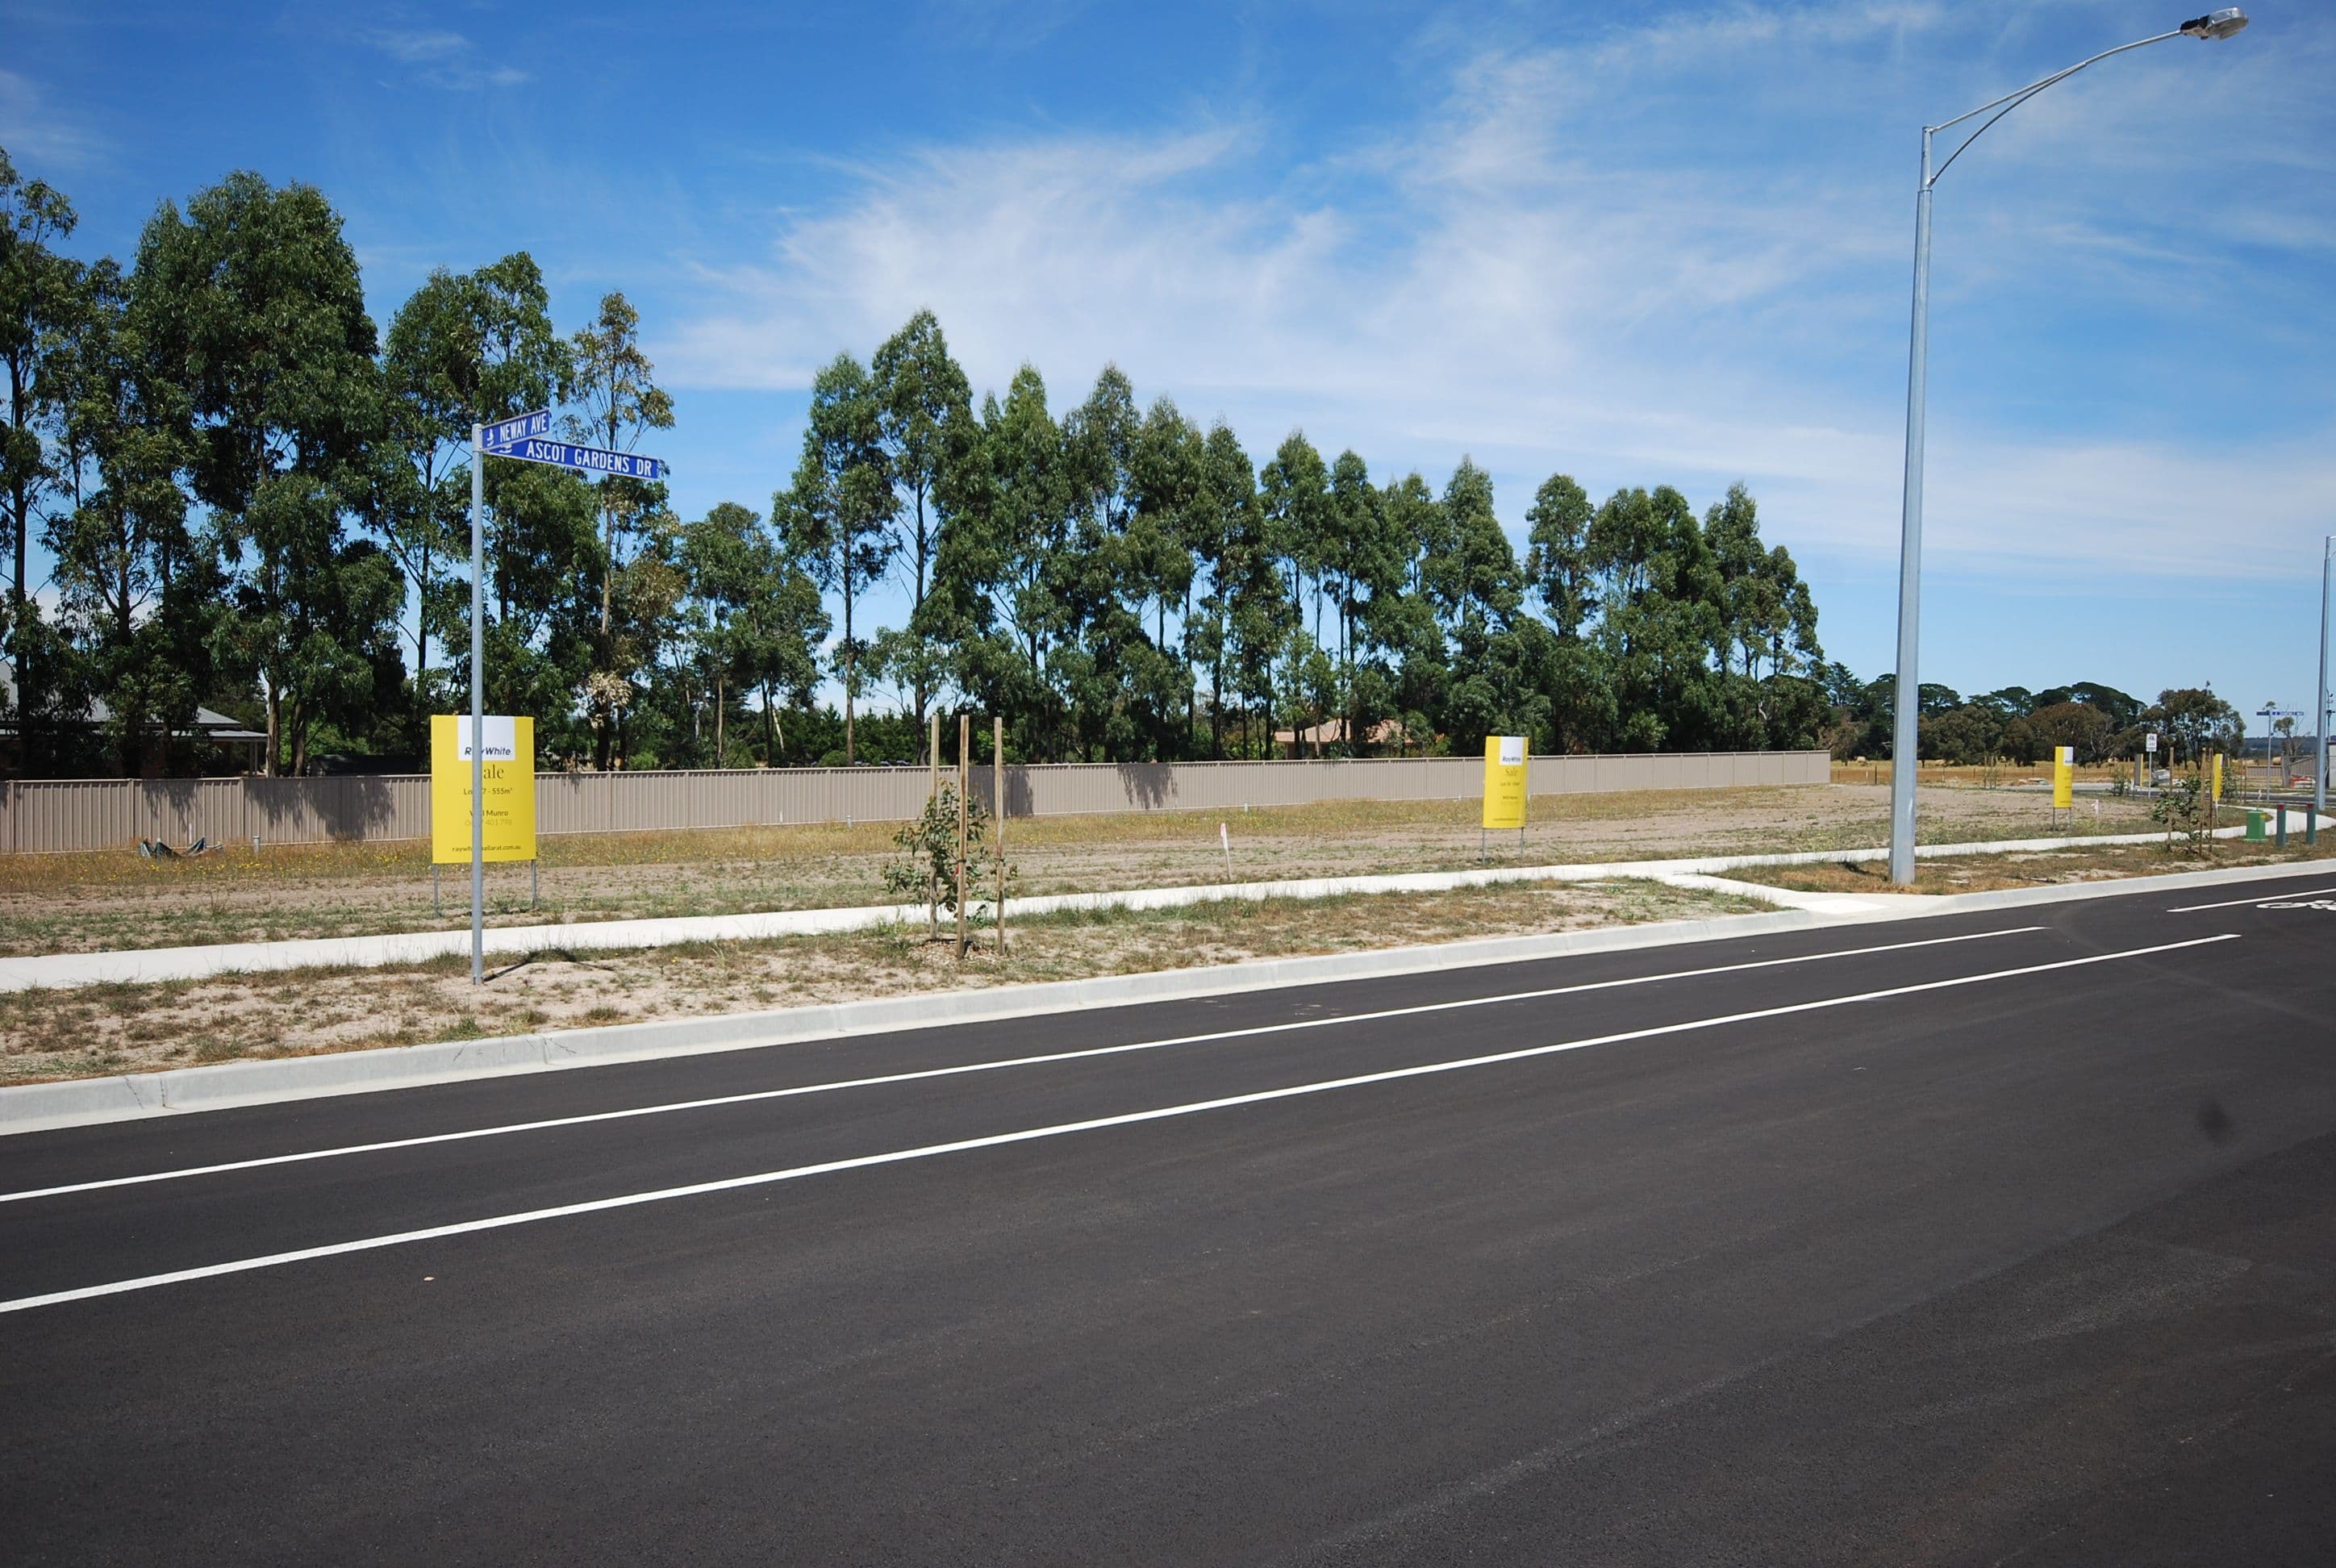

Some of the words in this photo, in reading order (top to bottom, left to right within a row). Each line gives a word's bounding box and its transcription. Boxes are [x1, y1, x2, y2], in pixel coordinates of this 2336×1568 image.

[499, 419, 527, 443] NEWAY
[530, 413, 548, 434] AVE
[526, 441, 566, 463] ASCOT
[574, 448, 630, 473] GARDENS
[636, 461, 653, 477] DR
[464, 747, 511, 756] RWhite
[482, 764, 504, 779] ale
